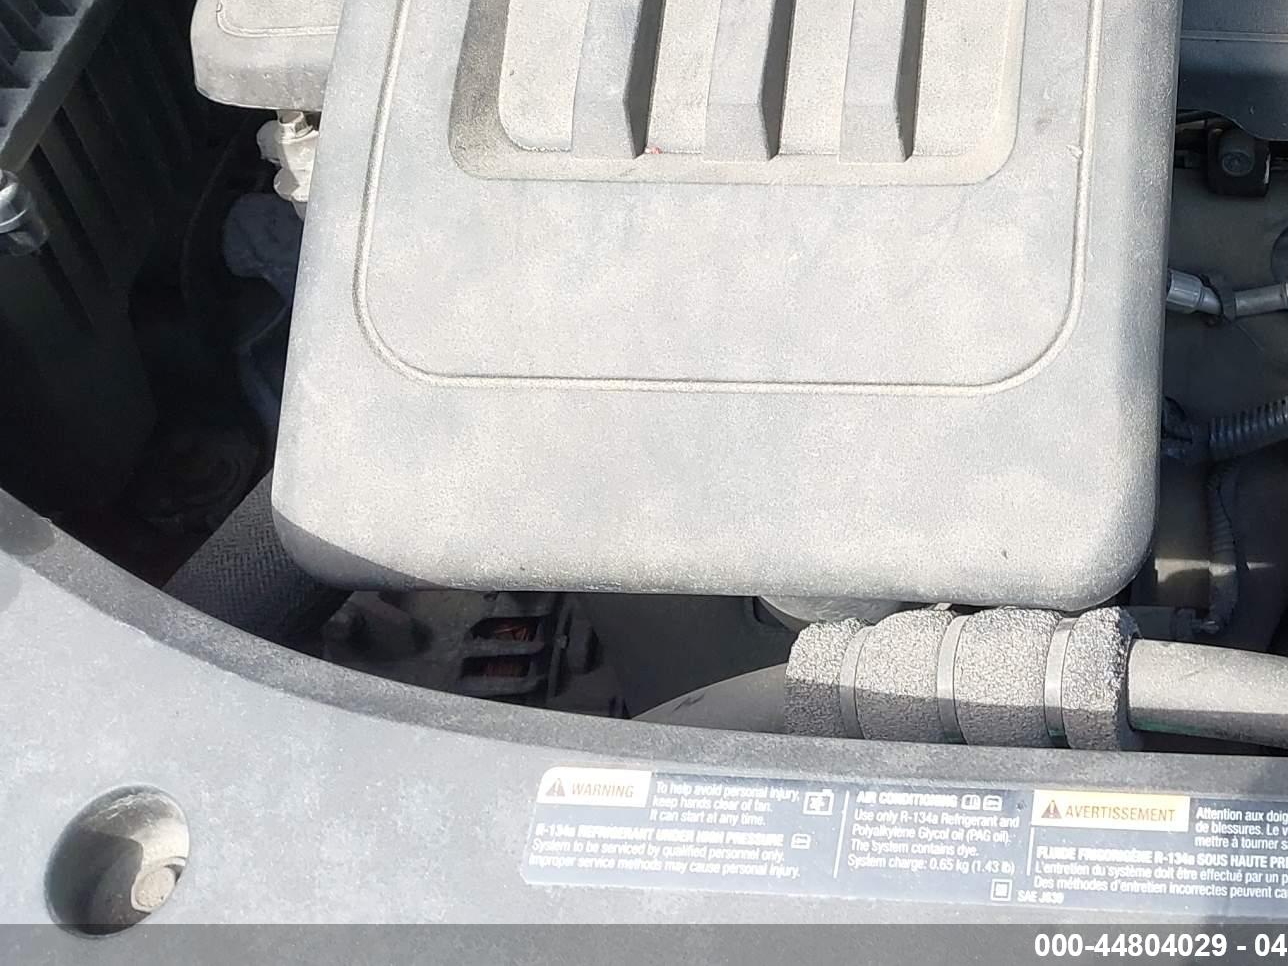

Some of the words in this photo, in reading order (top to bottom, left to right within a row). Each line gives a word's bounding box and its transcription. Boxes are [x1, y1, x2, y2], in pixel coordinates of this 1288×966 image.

[572, 783, 634, 798] WARNING
[657, 781, 667, 794] To
[670, 783, 693, 796] help
[694, 785, 722, 796] avoid
[724, 788, 768, 798] personal
[652, 796, 677, 808] keep
[680, 796, 711, 808] hands
[713, 799, 738, 810] clear
[741, 800, 752, 811] of
[755, 800, 772, 812] fan.
[856, 792, 876, 804] AIR
[879, 793, 958, 808] CONDITIONING
[650, 809, 658, 820] It
[660, 811, 678, 821] can
[681, 811, 705, 823] start
[707, 813, 718, 823] at
[719, 814, 738, 825] any
[741, 813, 766, 826] time.
[854, 809, 873, 821] Use
[876, 812, 898, 824] only
[900, 812, 938, 824] R-134a
[940, 814, 997, 828] Refrigerant
[999, 816, 1019, 827] and
[1066, 804, 1175, 822] AVERTISSEMENT
[1196, 807, 1243, 822] Attention
[1245, 812, 1264, 822] aux
[852, 825, 915, 840] Polyalkylene
[918, 827, 949, 840] Glycol
[951, 828, 963, 840] oil
[967, 829, 990, 843] (PAG
[1195, 821, 1209, 833] de
[1212, 823, 1263, 835] blessures.
[1266, 824, 1279, 836] Le
[532, 839, 571, 854] System
[574, 841, 583, 851] to
[586, 842, 599, 853] be
[601, 843, 644, 855] serviced
[647, 844, 660, 858] by
[662, 846, 707, 858] qualified
[708, 848, 759, 861] personnel
[851, 838, 870, 851] The
[911, 843, 954, 856] contains
[957, 844, 979, 858] dye.
[1195, 835, 1229, 847] mettre
[1232, 835, 1239, 848] à
[1241, 837, 1279, 850] tourner
[529, 855, 576, 868] Improper
[578, 857, 615, 868] service
[617, 858, 662, 871] methods
[664, 861, 687, 874] may
[689, 863, 720, 874] cause
[722, 863, 767, 875] personal
[848, 854, 886, 869] System
[888, 856, 927, 872] charge:
[956, 859, 969, 874] kg
[1001, 861, 1015, 875] lb)
[1196, 852, 1228, 867] SOUS
[1231, 855, 1267, 868] HAUTE
[1092, 863, 1106, 876] du
[1154, 866, 1174, 879] doit
[1199, 869, 1242, 883] effectué
[1245, 872, 1261, 884] par
[1265, 873, 1279, 883] un
[1034, 876, 1054, 888] Des
[1169, 881, 1227, 897] incorrectes
[1230, 887, 1272, 899] peuvent
